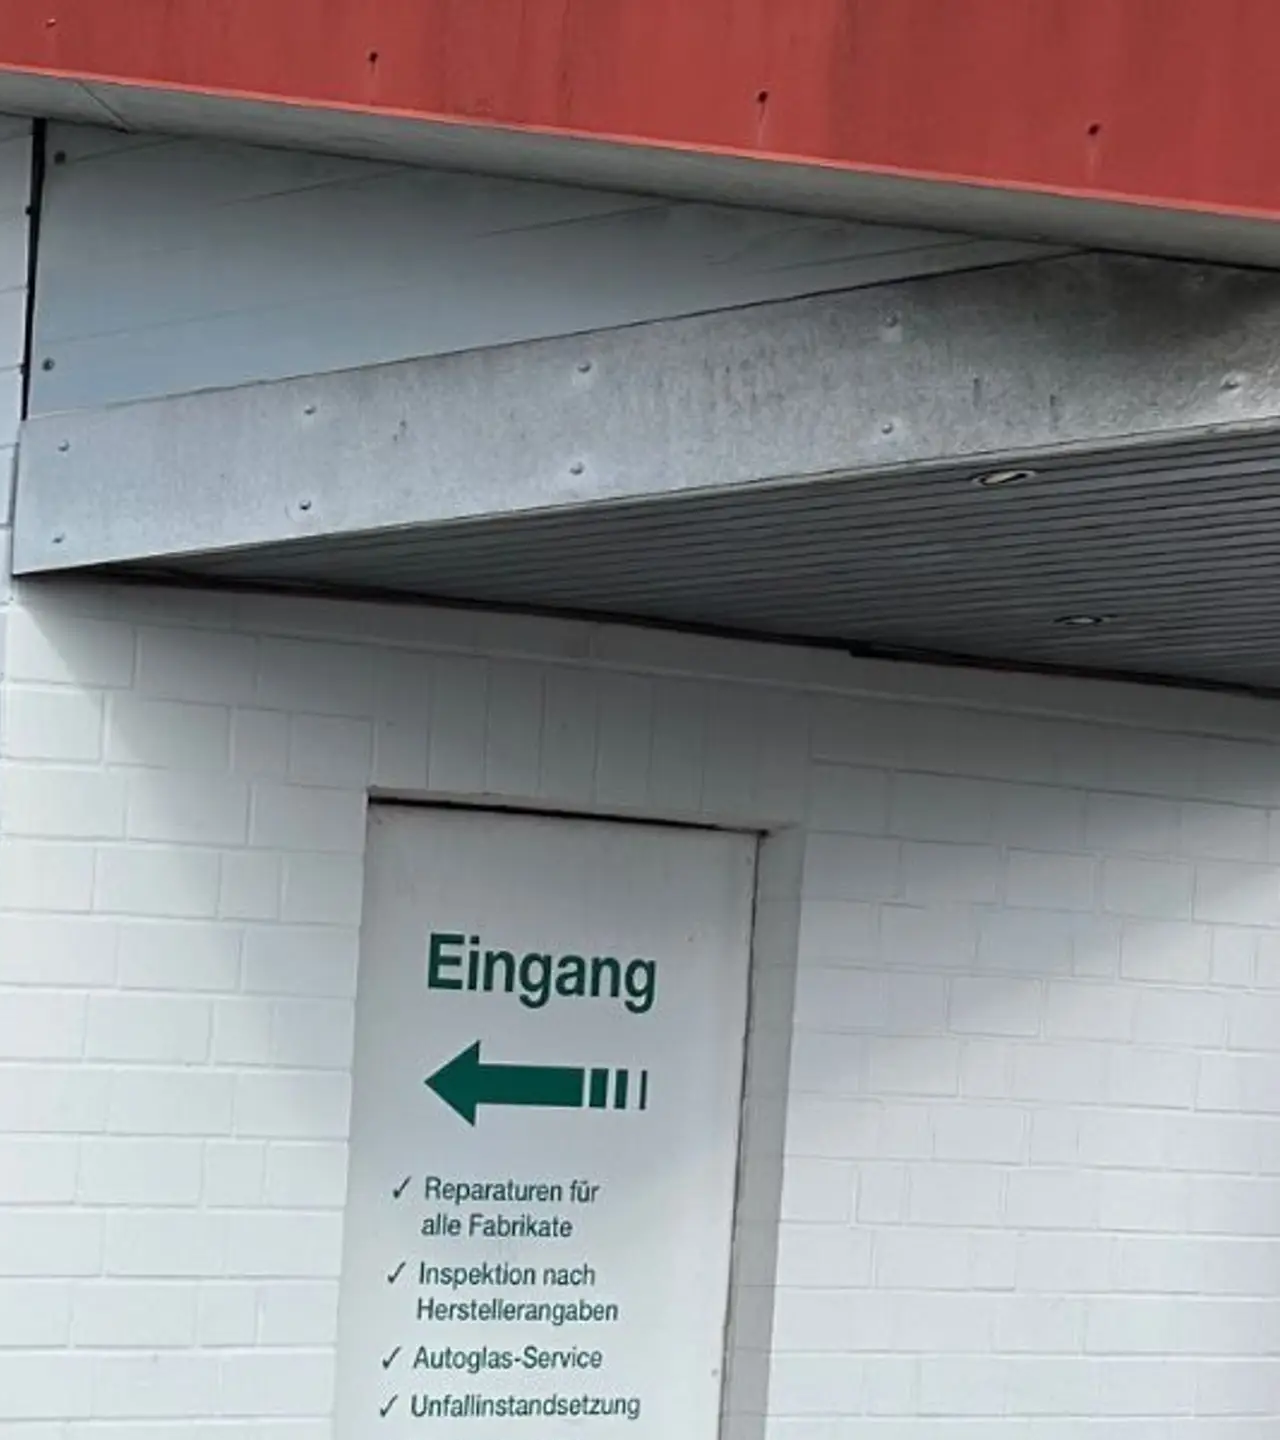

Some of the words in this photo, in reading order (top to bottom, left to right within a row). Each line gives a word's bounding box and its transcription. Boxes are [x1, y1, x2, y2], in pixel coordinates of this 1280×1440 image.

[427, 933, 656, 1013] Eingang
[424, 1176, 561, 1204] Reparaturen
[570, 1180, 600, 1203] für
[421, 1213, 461, 1237] alle
[468, 1213, 573, 1238] Fabrikate
[418, 1261, 536, 1290] Inspektion
[543, 1263, 596, 1286] nach
[416, 1297, 618, 1326] Herstellerangaben
[413, 1346, 603, 1373] Autoglas-Service
[410, 1393, 641, 1420] Unfallinstandsetzung
